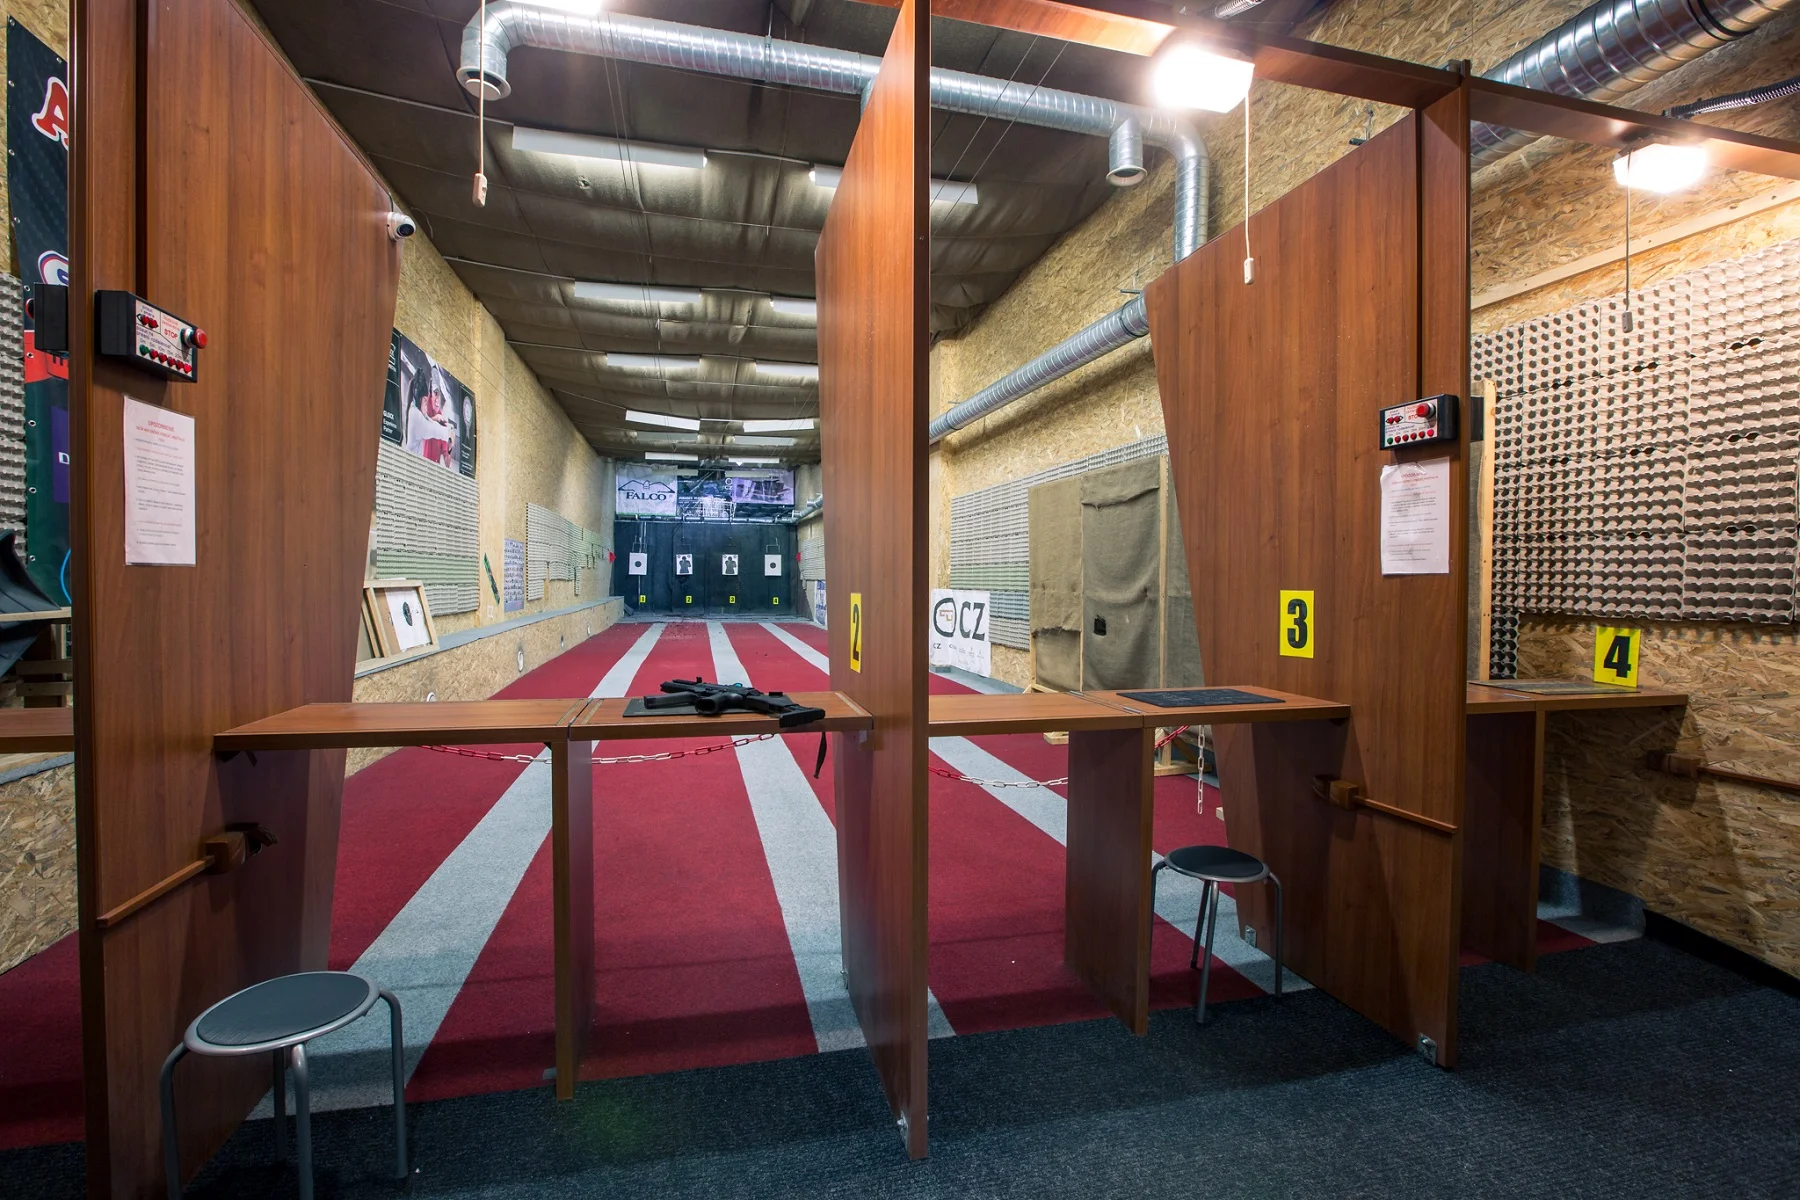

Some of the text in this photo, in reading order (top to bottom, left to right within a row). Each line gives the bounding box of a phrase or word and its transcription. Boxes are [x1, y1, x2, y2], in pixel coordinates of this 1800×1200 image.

[164, 329, 178, 340] STOP
[626, 491, 667, 501] FALCO
[852, 603, 860, 662] 2
[959, 601, 986, 641] CZ
[1286, 598, 1308, 649] 3
[1603, 635, 1632, 679] 4
